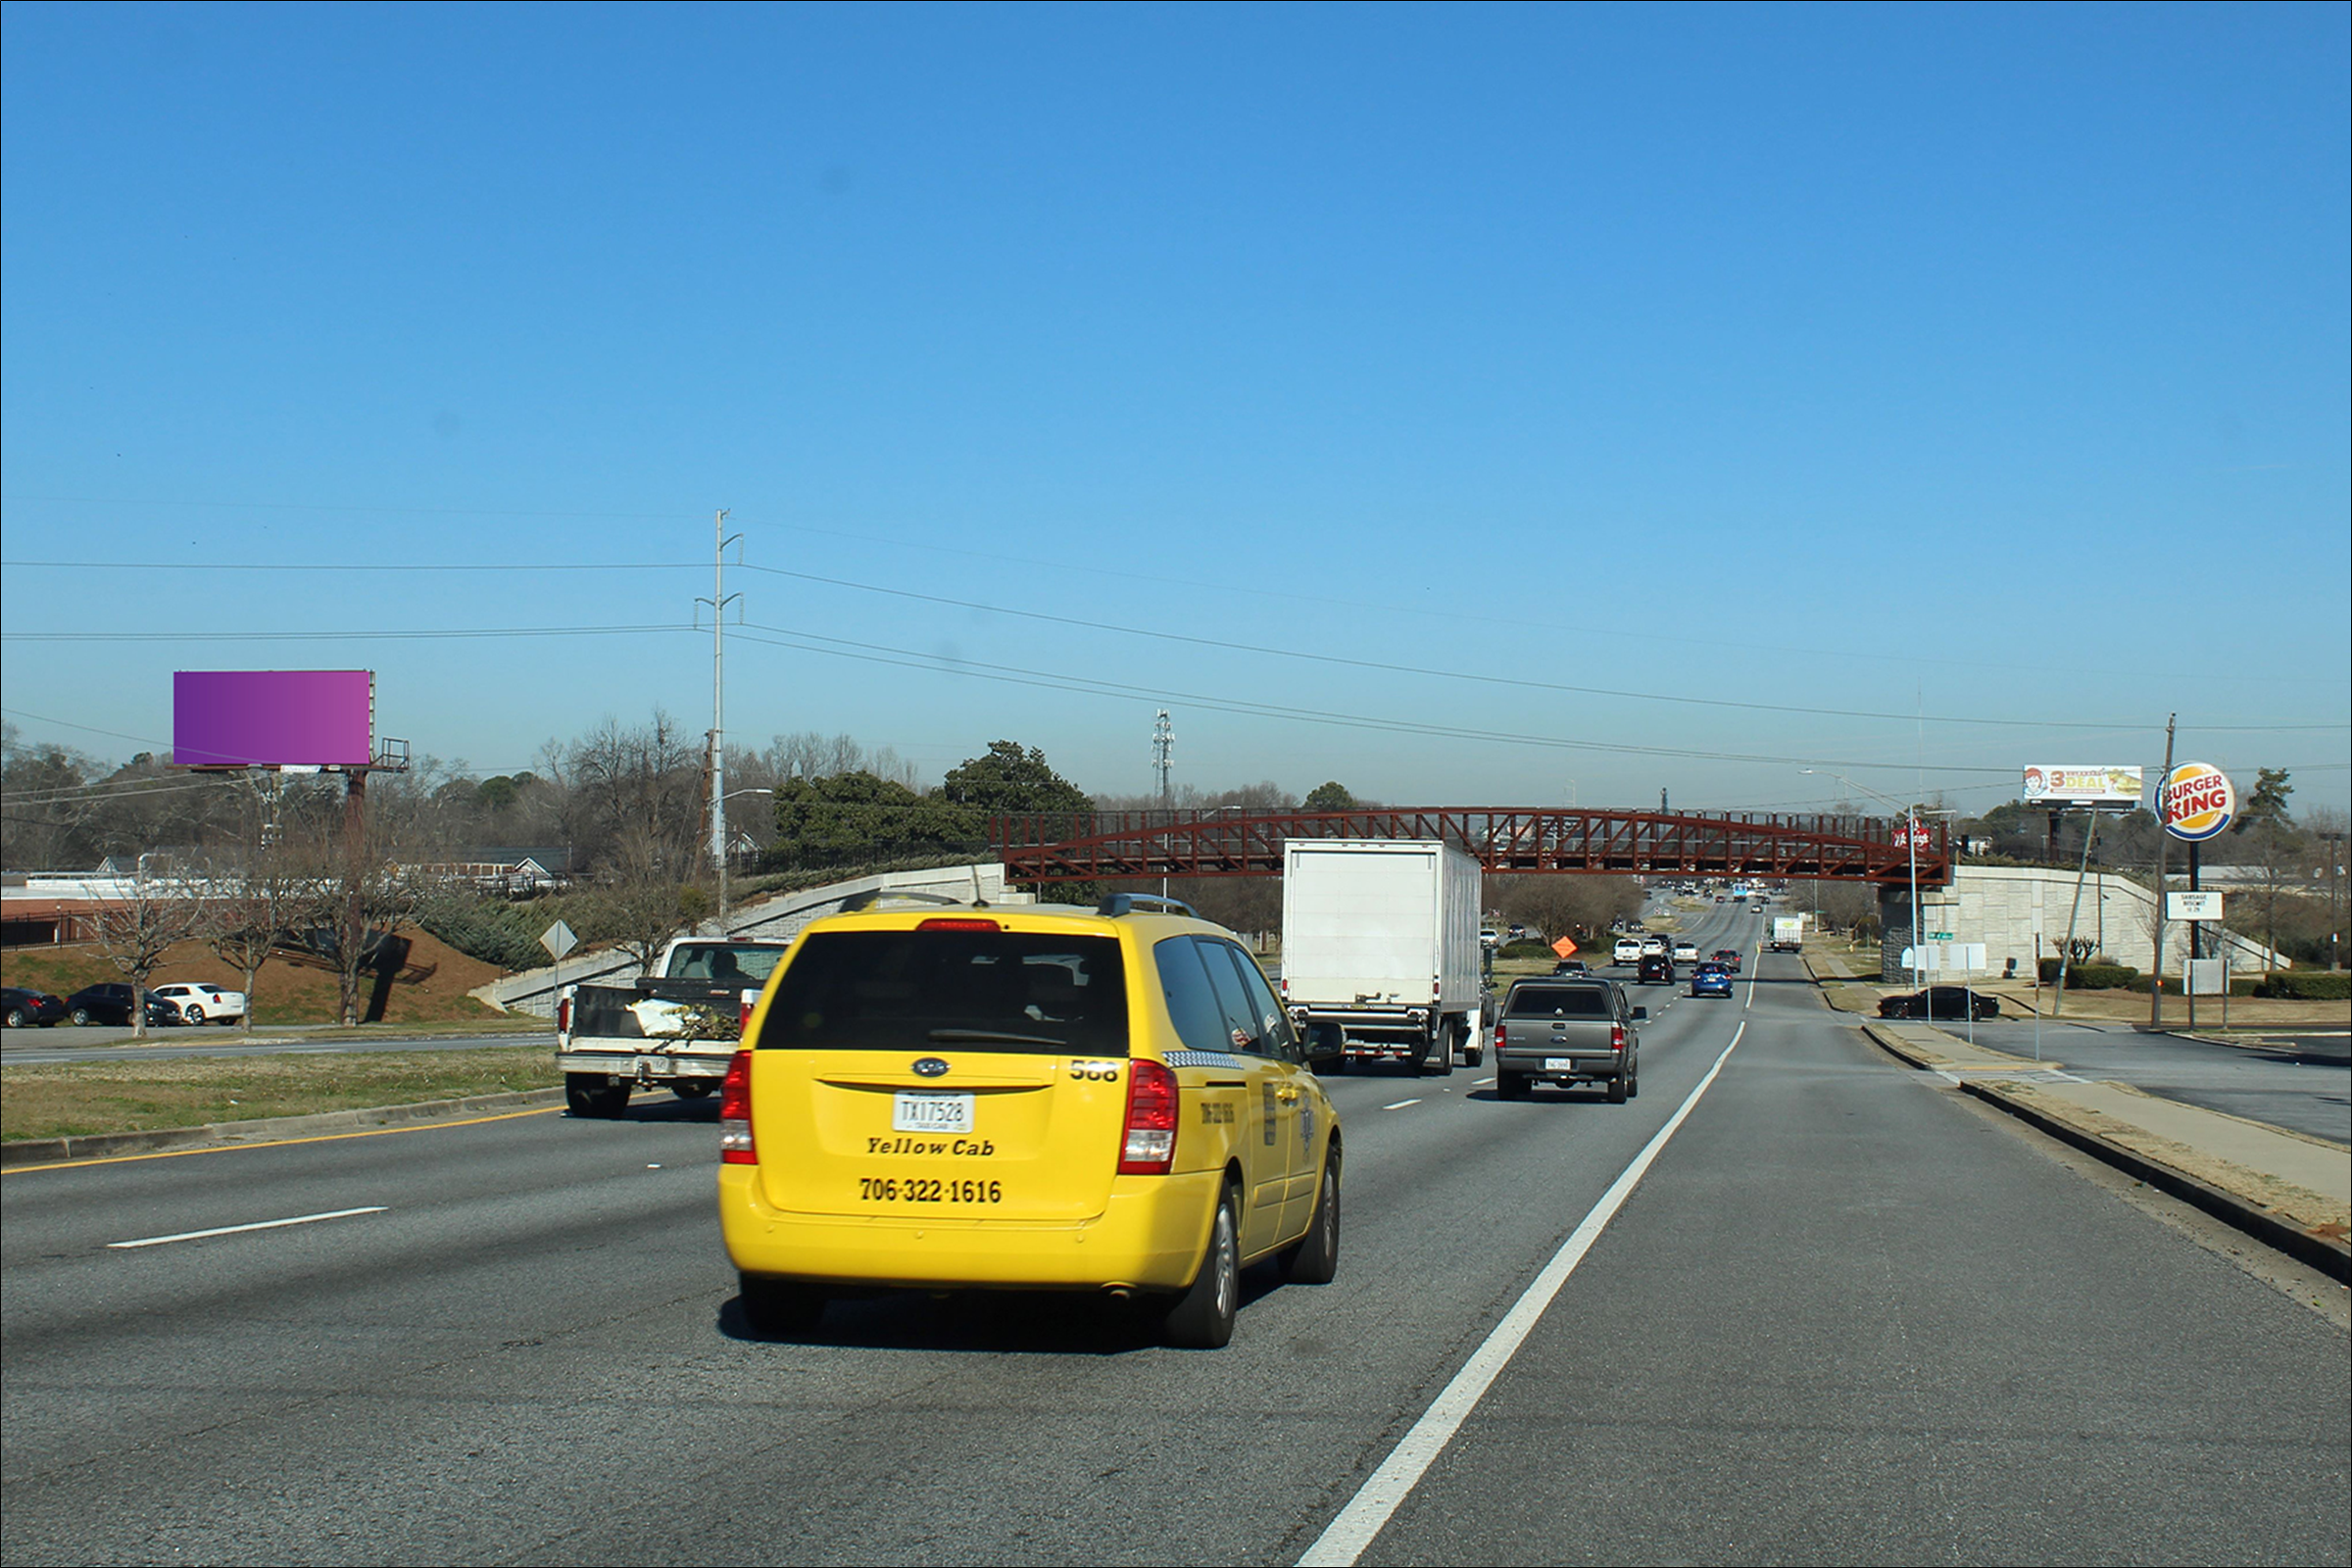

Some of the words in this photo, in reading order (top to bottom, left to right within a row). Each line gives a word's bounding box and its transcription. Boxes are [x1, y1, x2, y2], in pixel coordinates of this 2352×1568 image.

[2065, 777, 2106, 788] DEAL
[2167, 789, 2227, 825] KING
[900, 1101, 964, 1121] TX17528
[866, 1137, 948, 1154] Yellow
[952, 1139, 995, 1155] Cab
[859, 1178, 1002, 1203] 706-322-1616
